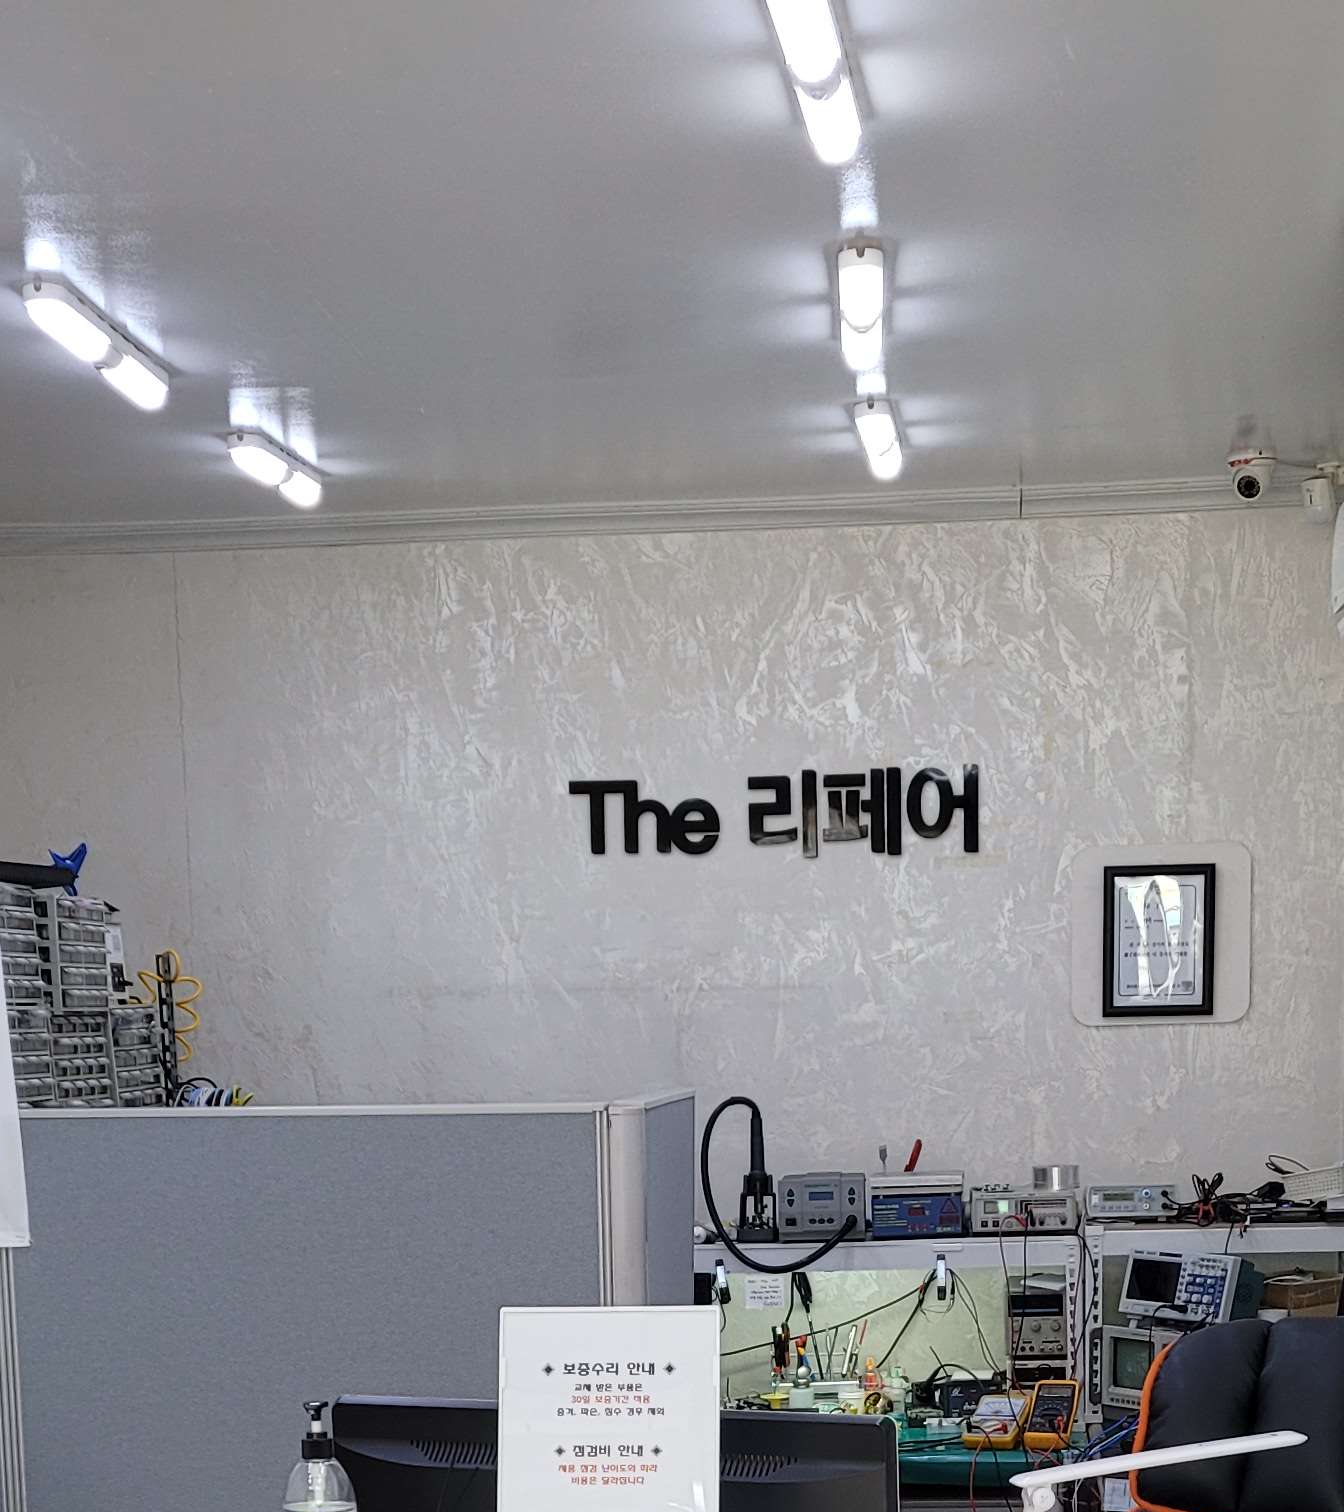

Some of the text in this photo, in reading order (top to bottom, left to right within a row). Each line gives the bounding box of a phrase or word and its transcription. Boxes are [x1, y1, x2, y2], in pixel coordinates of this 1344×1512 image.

[568, 763, 979, 858] The 리페어
[563, 1362, 655, 1377] 보증수리 안내
[573, 1444, 644, 1458] 점검비 안내
